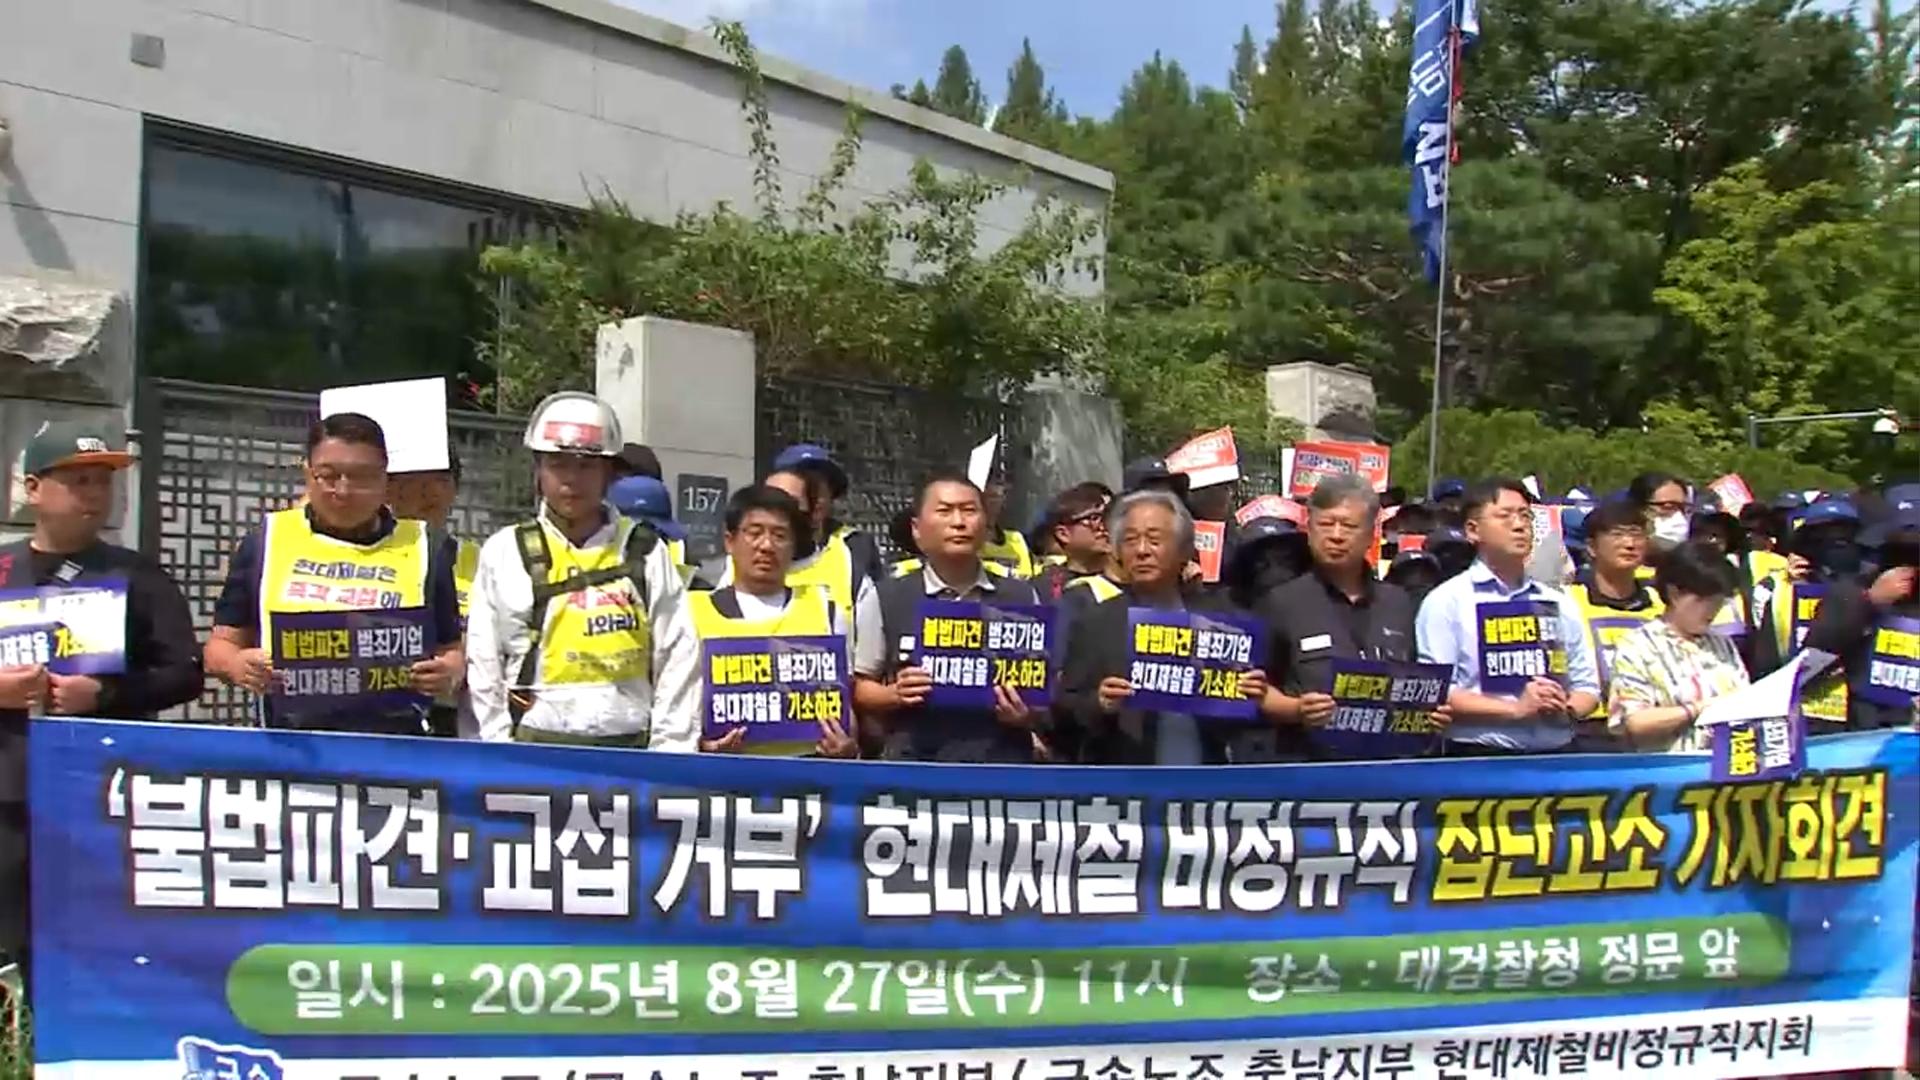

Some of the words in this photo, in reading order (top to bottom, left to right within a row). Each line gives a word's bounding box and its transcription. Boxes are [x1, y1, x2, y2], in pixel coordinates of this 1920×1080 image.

[684, 487, 722, 512] 157
[281, 628, 351, 660] 불법파견
[357, 625, 425, 658] 범죄기업
[923, 617, 983, 648] 불법파견
[988, 621, 1045, 650] 범죄기업
[1135, 623, 1193, 657] 불법파견
[1196, 630, 1252, 663] 범죄기업
[1484, 615, 1537, 644] 불법파견
[368, 665, 411, 691] 기소하
[711, 654, 773, 685] 불법파견
[777, 652, 837, 683] 범죄기업
[993, 658, 1046, 689] 기소하라
[787, 690, 842, 720] 기소하라
[1391, 677, 1443, 703] 범죄기업
[863, 793, 1145, 918] 현대제철
[1160, 799, 1419, 912] 비정규직
[1432, 791, 1665, 902] 집단고소
[1674, 769, 1889, 888] 기자회견
[287, 958, 405, 1020] 일시
[470, 959, 680, 1019] 2025년
[706, 957, 799, 1019] 8월
[822, 957, 1045, 1017] 27일(수)
[1073, 955, 1189, 1008] 11시
[1245, 953, 1342, 1003] 장소
[1397, 936, 1581, 995] 대검찰청
[1598, 930, 1685, 986] 정문
[1699, 926, 1741, 981] 앞
[1433, 1014, 1815, 1080] 현대제철비정규직지회
